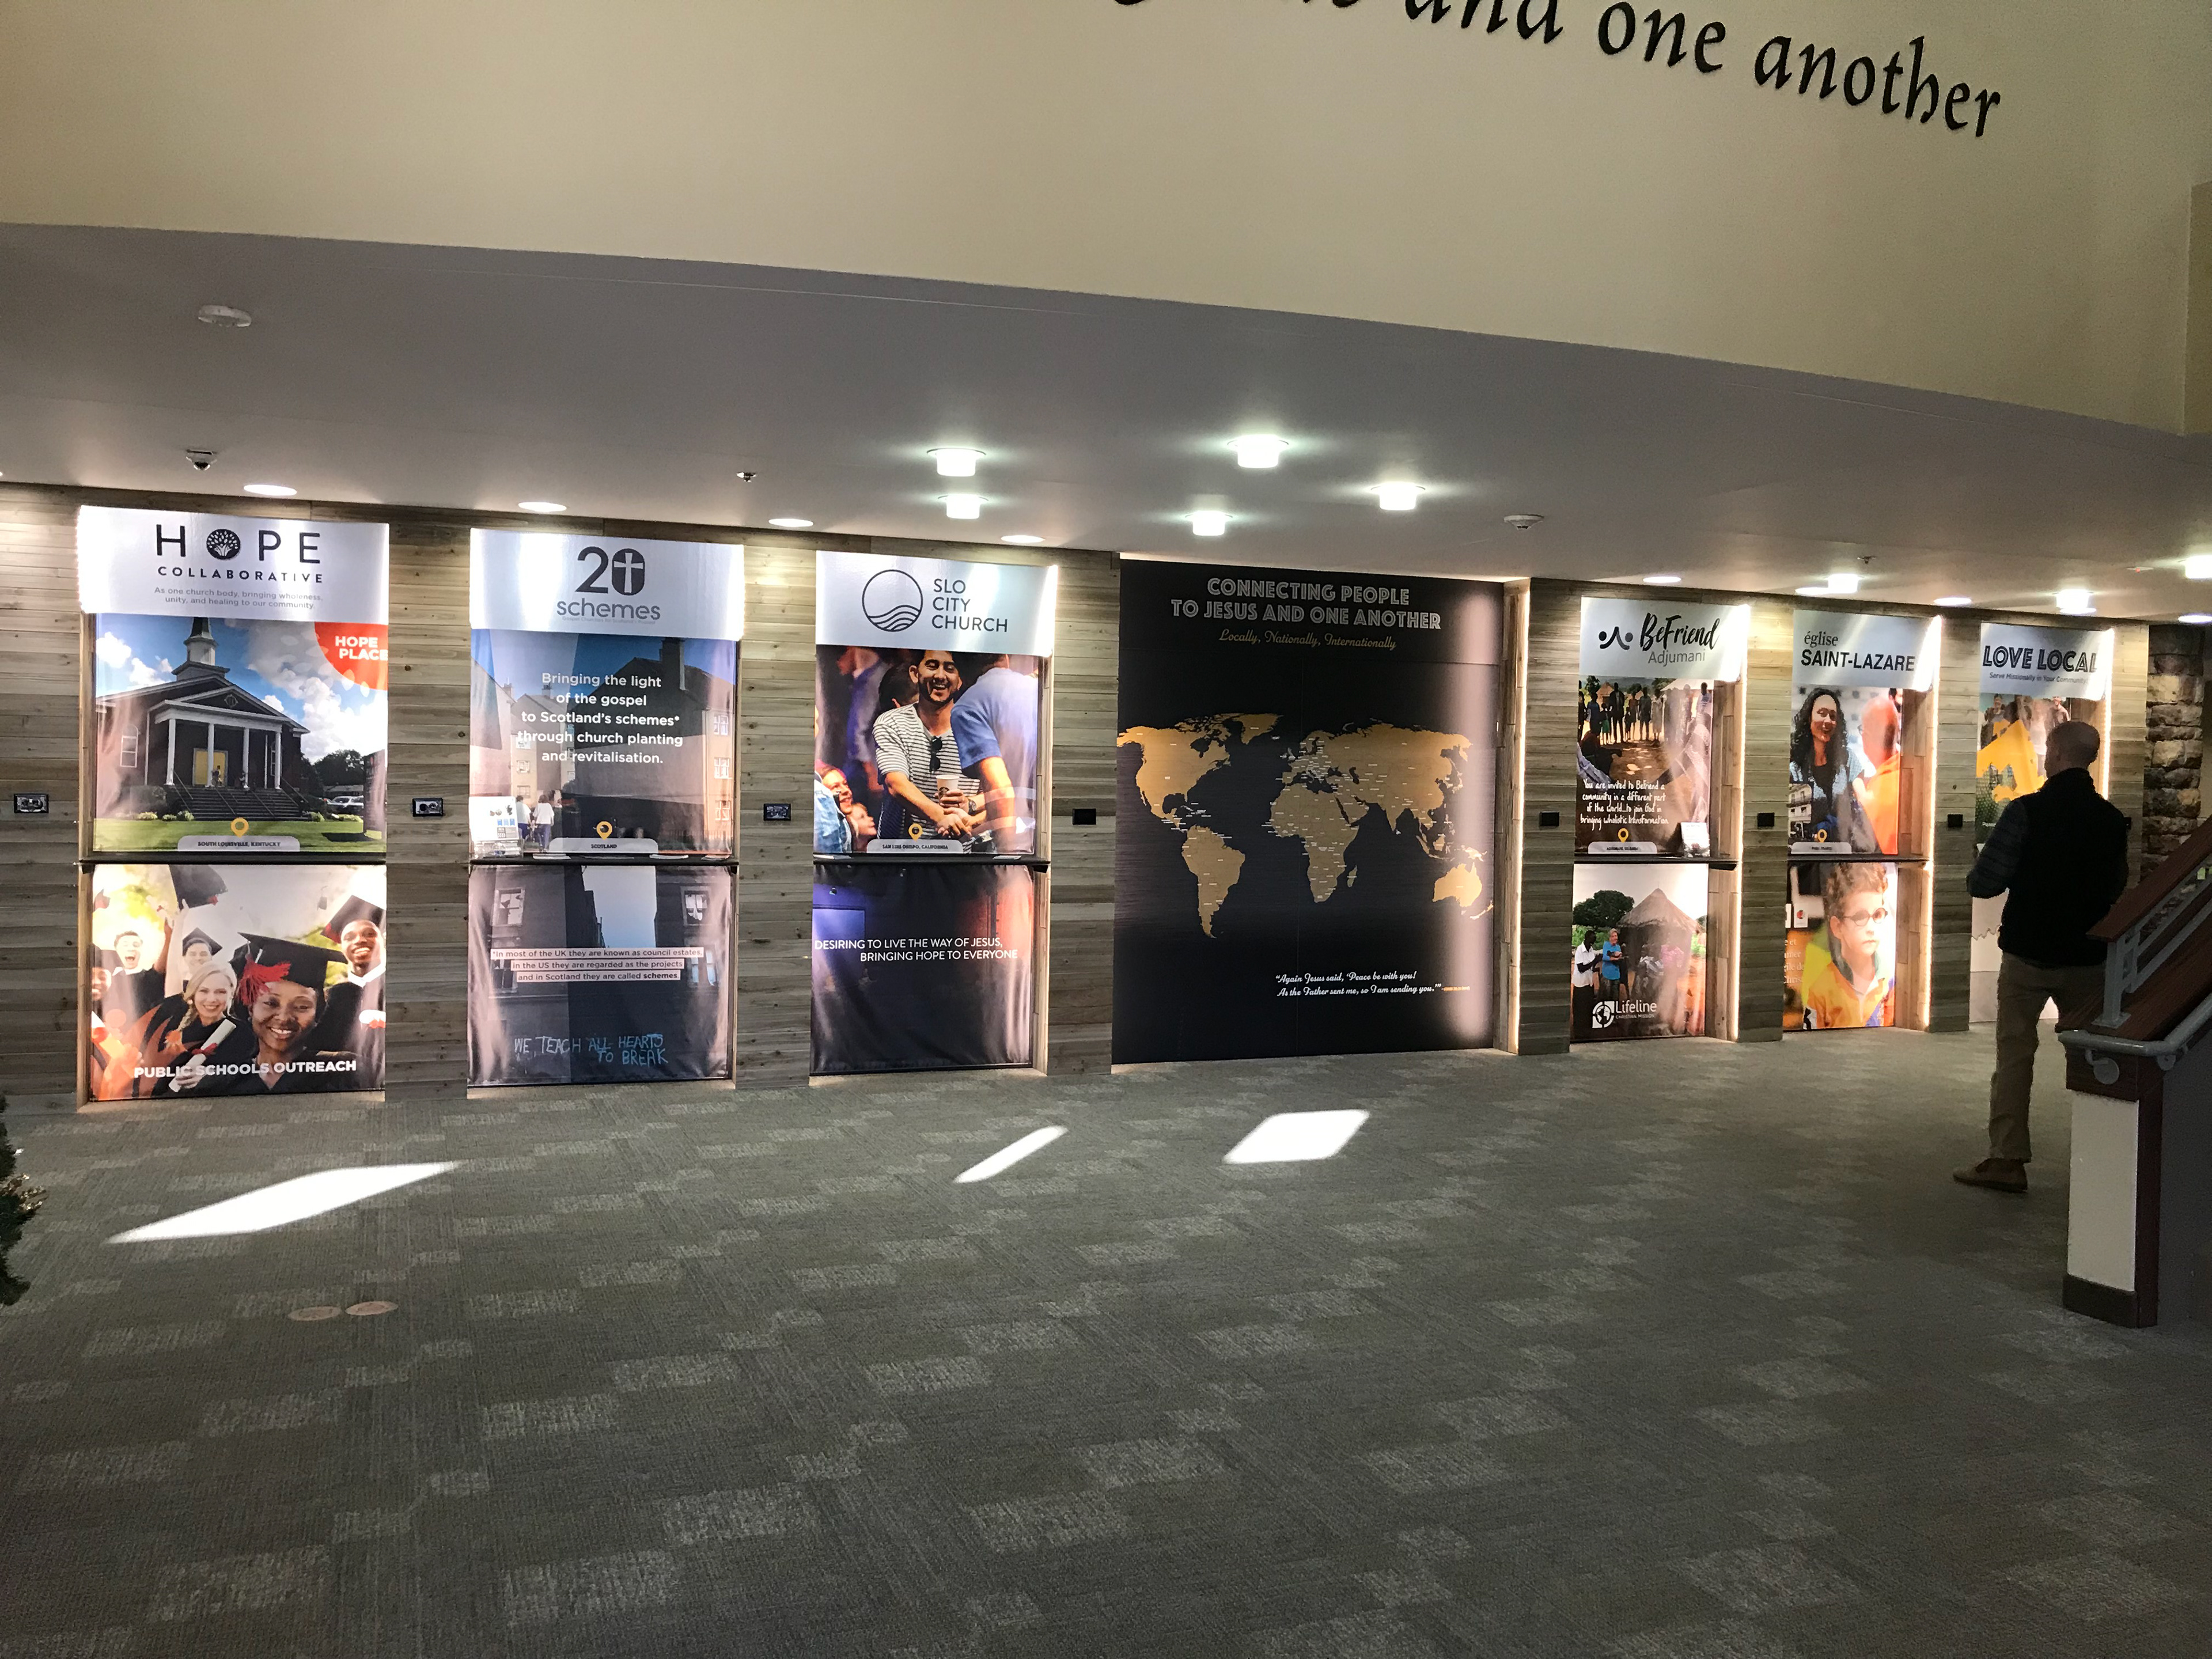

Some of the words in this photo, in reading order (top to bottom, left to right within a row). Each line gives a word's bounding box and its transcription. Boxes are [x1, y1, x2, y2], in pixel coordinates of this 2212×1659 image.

[1598, 1, 1726, 73] one
[1754, 35, 2001, 137] another
[156, 524, 320, 563] HOPE
[158, 566, 322, 583] COLLABORATIVE
[575, 546, 645, 596] 20
[933, 578, 966, 594] SLO
[1207, 578, 1335, 601] CONNECTING
[1341, 585, 1409, 605] PEOPLE
[208, 598, 238, 606] healing
[242, 591, 276, 600] bringing
[556, 598, 661, 620] schemes
[933, 597, 971, 612] CITY
[1171, 600, 1199, 618] TO
[1204, 601, 1257, 620] JESUS
[1263, 605, 1304, 623] AND
[1310, 607, 1349, 625] ONE
[1354, 609, 1441, 630] ANOTHER
[931, 615, 1007, 632] CHURCH
[1640, 612, 1720, 651] BeFriend
[335, 636, 378, 648] HOPE
[1218, 628, 1261, 644] Locally,
[1265, 630, 1320, 647] Nationally,
[1324, 634, 1396, 651] Internationally
[1804, 631, 1838, 648] église
[339, 649, 388, 661] PLACE
[1648, 649, 1706, 667] Adjumani
[1801, 649, 1915, 671] SAINT-LAZARE
[1983, 645, 2033, 669] LOVE
[2037, 649, 2097, 673] LOCAL
[542, 673, 600, 686] Bringing
[605, 675, 627, 685] the
[631, 676, 661, 688] light
[2006, 673, 2035, 681] Missionally
[556, 693, 570, 703] of
[574, 693, 597, 704] the
[601, 695, 647, 707] gospel
[521, 711, 536, 722] to
[540, 711, 611, 724] Scotland's
[517, 730, 573, 744] through
[577, 733, 623, 743] church
[627, 733, 683, 747] planting
[542, 751, 567, 762] and
[572, 752, 663, 764] revitalisation.
[1583, 778, 1593, 789] You
[1608, 779, 1626, 789] invited
[1628, 781, 1634, 789] to
[1582, 791, 1611, 806] community
[1627, 791, 1652, 801] different
[1654, 793, 1666, 806] part
[1586, 802, 1593, 812] of
[1594, 802, 1604, 812] the
[1634, 805, 1643, 818] join
[1645, 802, 1654, 813] God
[1580, 813, 1601, 831] bringing
[1604, 814, 1627, 824] wholistic
[815, 940, 865, 949] DESIRING
[867, 940, 882, 949] TO
[884, 939, 906, 948] LIVE
[908, 938, 927, 948] THE
[930, 938, 953, 947] WAY
[955, 938, 969, 947] OF
[971, 937, 1002, 948] JESUS,
[861, 952, 913, 961] BRINGING
[916, 951, 945, 960] HOPE
[947, 950, 961, 960] TO
[964, 949, 1018, 960] EVERYONE
[1304, 973, 1324, 984] Jesus
[1326, 972, 1344, 982] said,
[1373, 971, 1381, 980] be
[1382, 972, 1398, 980] with
[1400, 971, 1416, 981] you!
[1277, 988, 1288, 997] As
[1289, 987, 1302, 996] the
[1303, 986, 1328, 995] Father
[1330, 987, 1344, 995] sent
[1390, 984, 1418, 995] sending
[1616, 999, 1657, 1013] Lifeline
[514, 1038, 532, 1054] WE
[535, 1036, 581, 1054] TEACH
[597, 1050, 613, 1062] TO
[622, 1048, 669, 1066] BREAK
[134, 1065, 192, 1078] PUBLIC
[195, 1063, 269, 1076] SCHOOLS
[274, 1060, 357, 1073] OUTREACH
